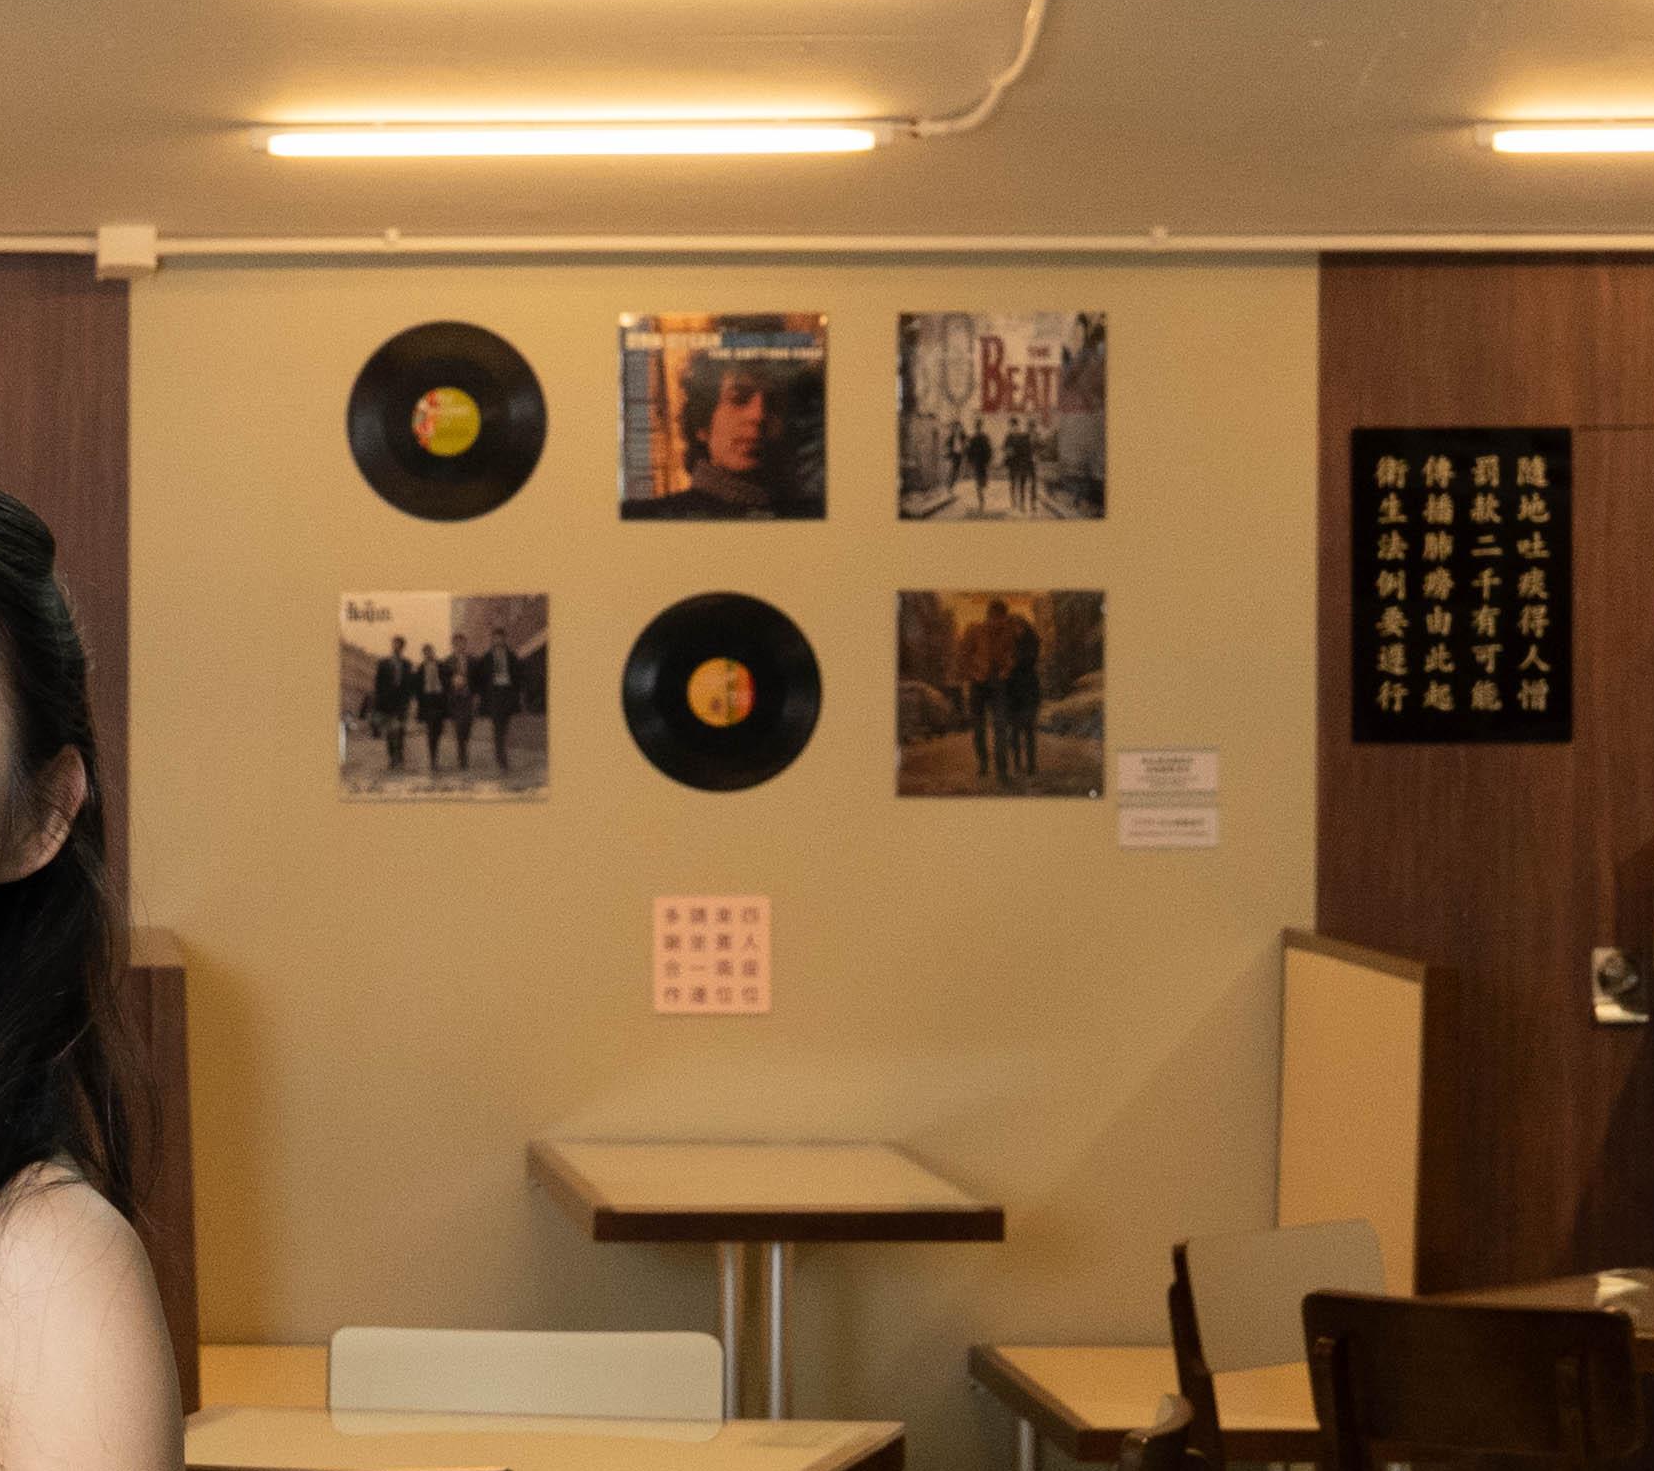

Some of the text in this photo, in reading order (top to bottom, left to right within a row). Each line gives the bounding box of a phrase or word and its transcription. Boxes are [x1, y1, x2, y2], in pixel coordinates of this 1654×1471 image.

[1422, 454, 1456, 713] 傳播肺癆由此起
[1470, 454, 1504, 713] 罰款二千有可能
[1515, 454, 1551, 713] 隨地吐痰得人憎
